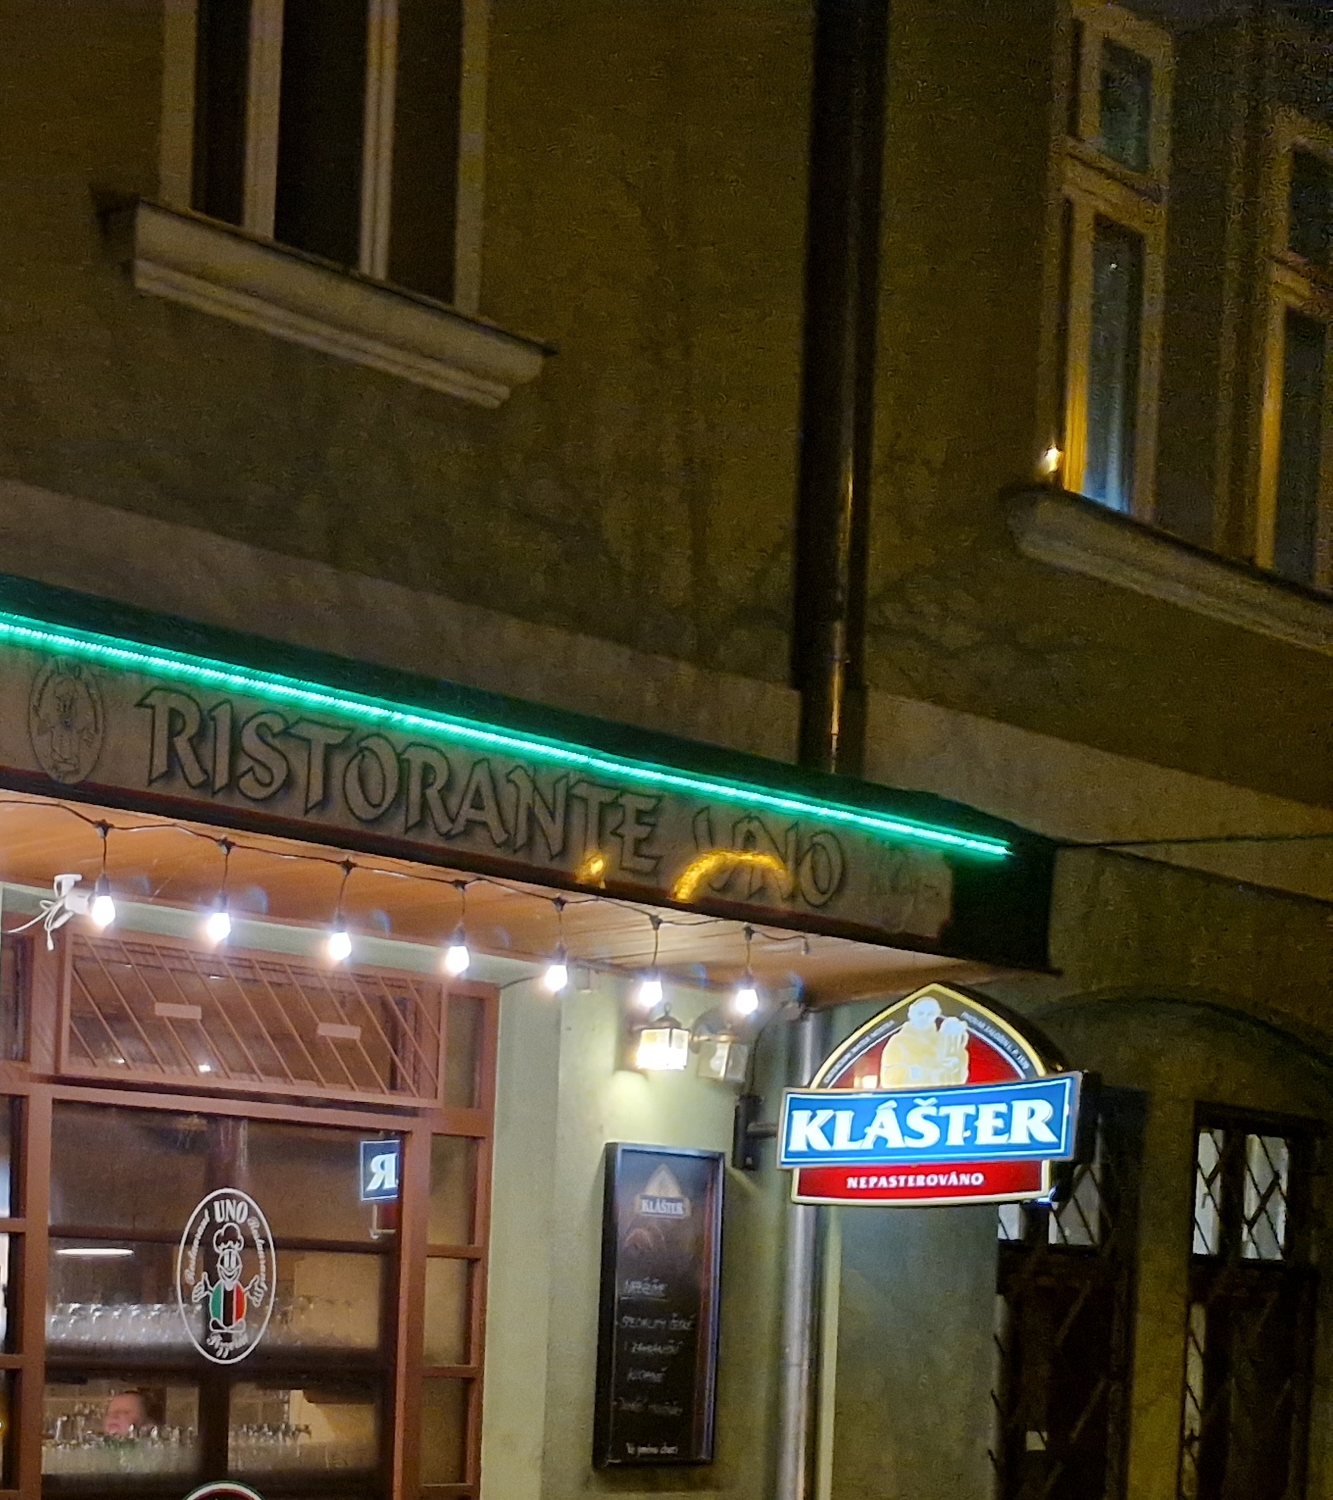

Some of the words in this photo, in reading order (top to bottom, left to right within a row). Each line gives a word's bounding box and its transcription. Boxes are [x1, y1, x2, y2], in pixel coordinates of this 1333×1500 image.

[135, 686, 665, 876] RISTORANTE
[691, 805, 845, 908] UNO
[787, 1097, 1059, 1152] KLÁŠTER
[846, 1172, 985, 1189] NEPASTEROVÁNO
[213, 1199, 248, 1223] UNO
